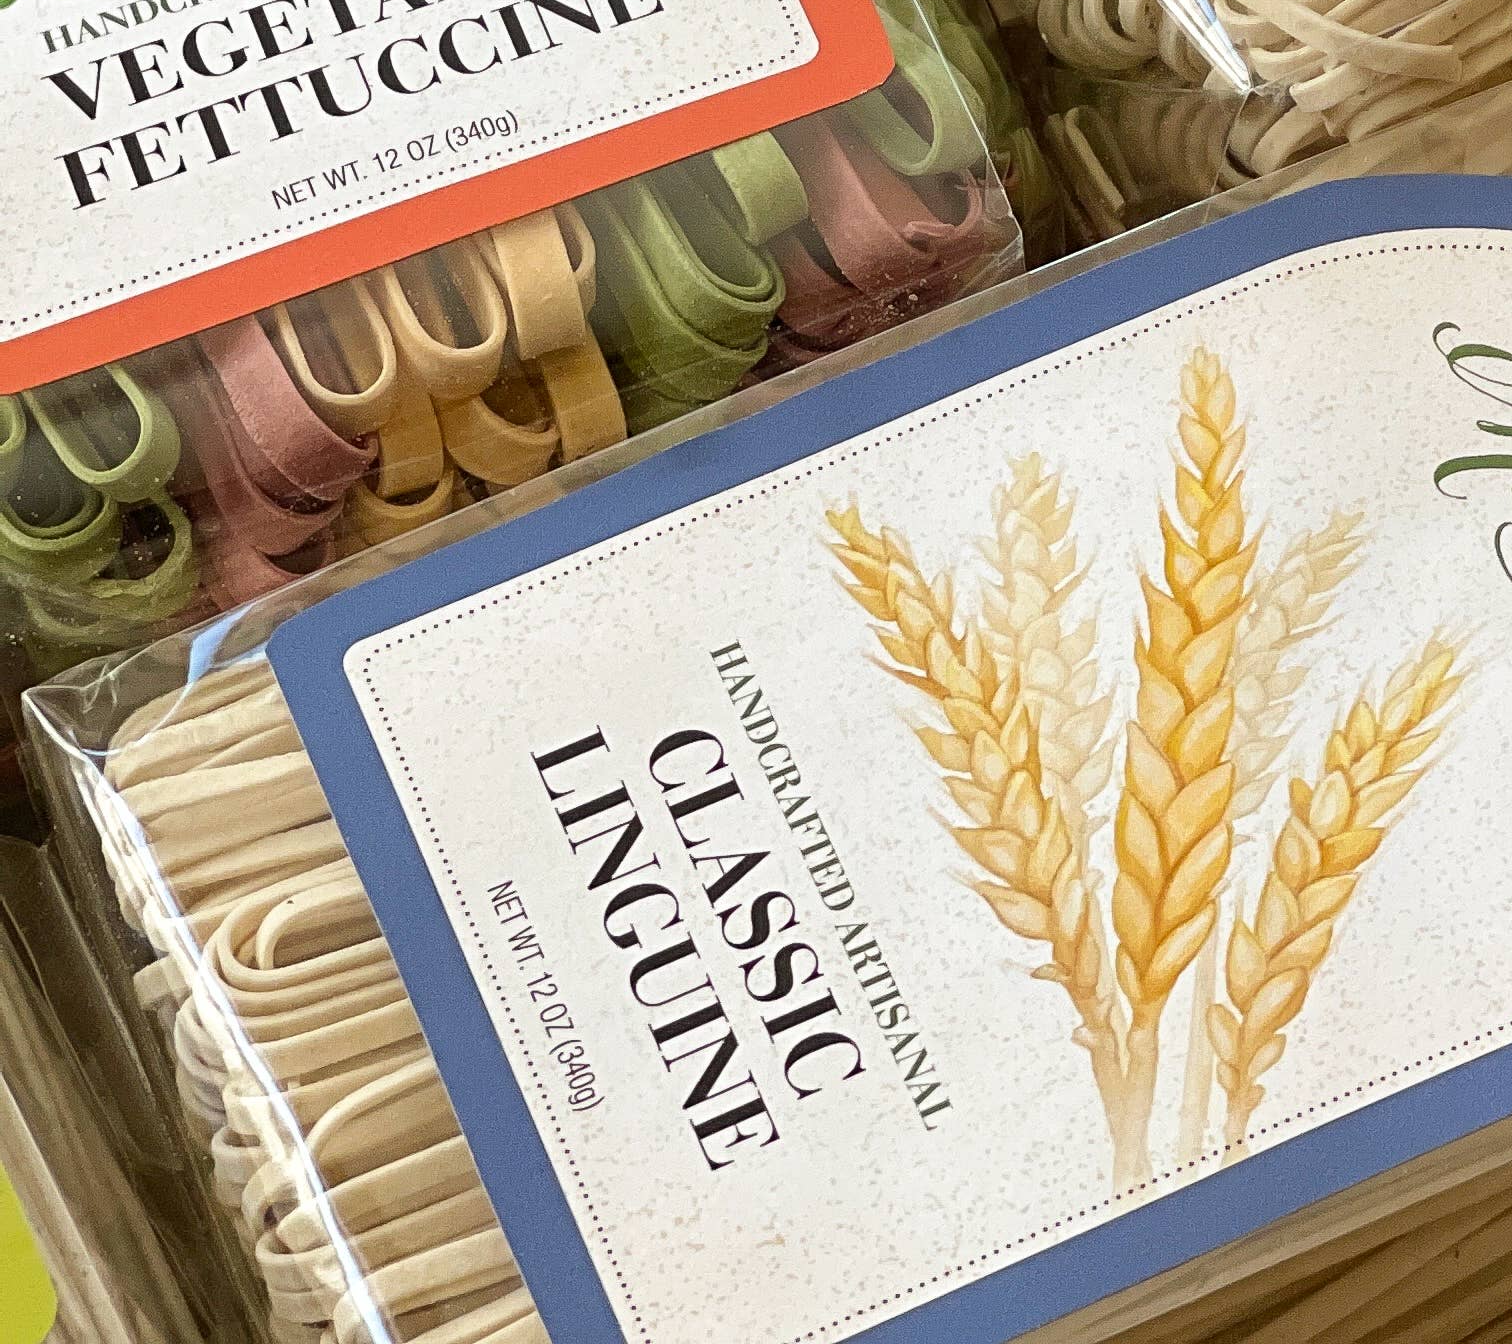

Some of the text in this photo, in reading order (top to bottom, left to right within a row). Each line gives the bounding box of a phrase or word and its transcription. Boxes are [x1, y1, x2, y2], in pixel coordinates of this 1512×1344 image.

[270, 109, 519, 211] NET WT. 12 OZ (340g)
[487, 879, 605, 1112] NET WT. 12 OZ (340g)
[529, 724, 781, 1172] LINGUINE
[648, 728, 867, 1101] CLASSIC
[709, 638, 954, 1132] HANDCRAFTED ARTISANAL
